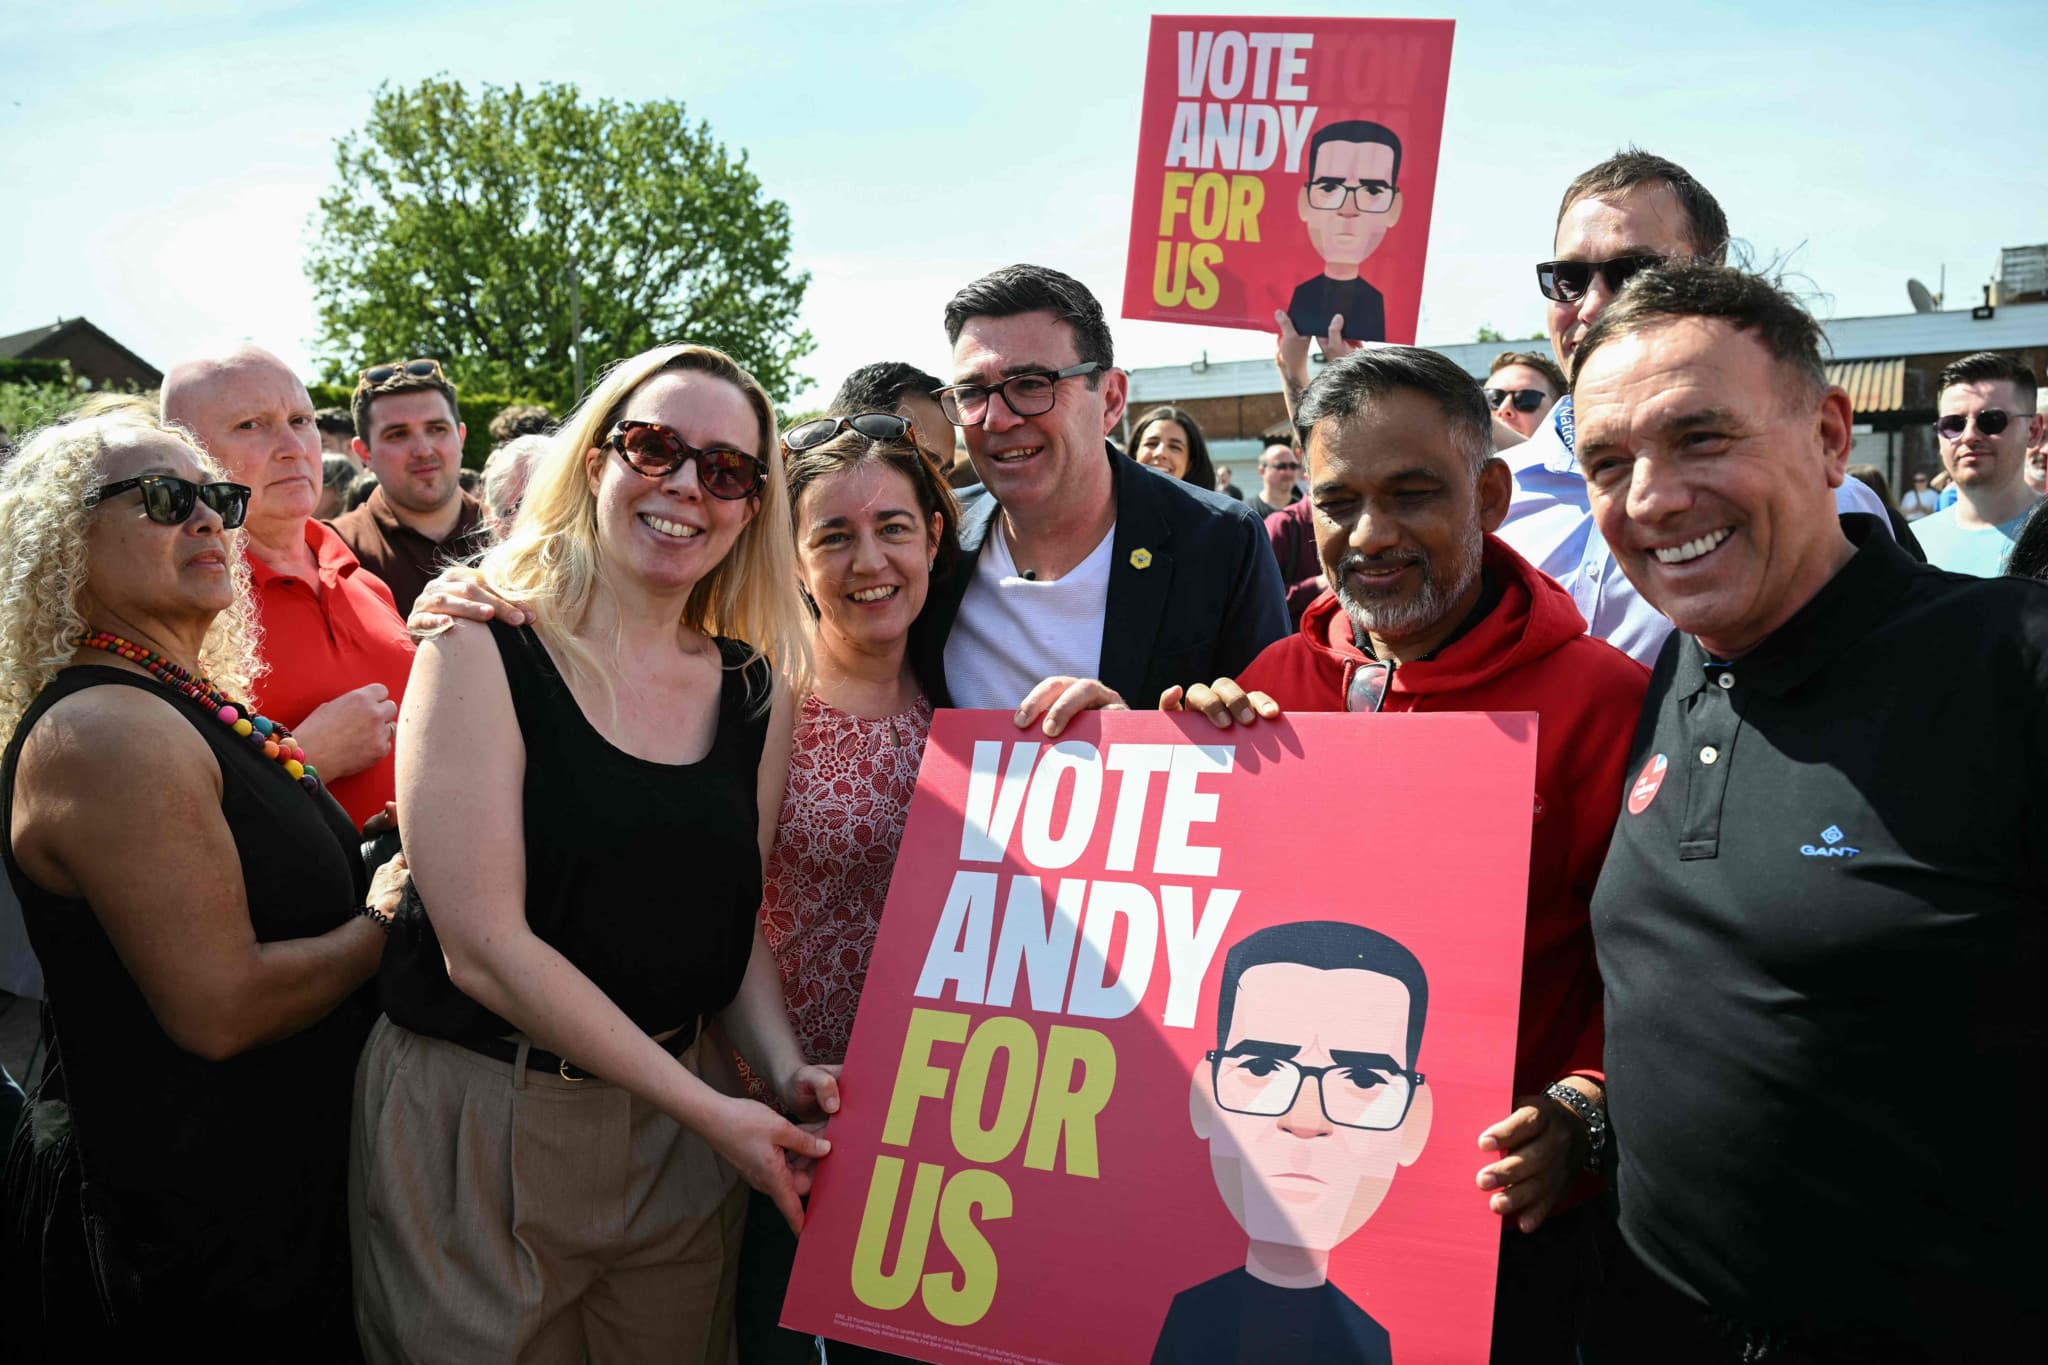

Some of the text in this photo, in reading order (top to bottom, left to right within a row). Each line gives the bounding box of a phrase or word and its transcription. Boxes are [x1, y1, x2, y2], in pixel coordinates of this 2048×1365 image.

[1178, 30, 1314, 102] VOTE
[1165, 102, 1318, 173] ANDY
[1159, 171, 1265, 243] FOR
[1153, 240, 1224, 310] US
[1559, 406, 1575, 451] Natio
[959, 740, 1236, 878] VOTE
[1800, 845, 1860, 859] GANT
[913, 870, 1243, 1030] ANDY
[882, 1008, 1116, 1179] FOR
[851, 1155, 1013, 1326] US
